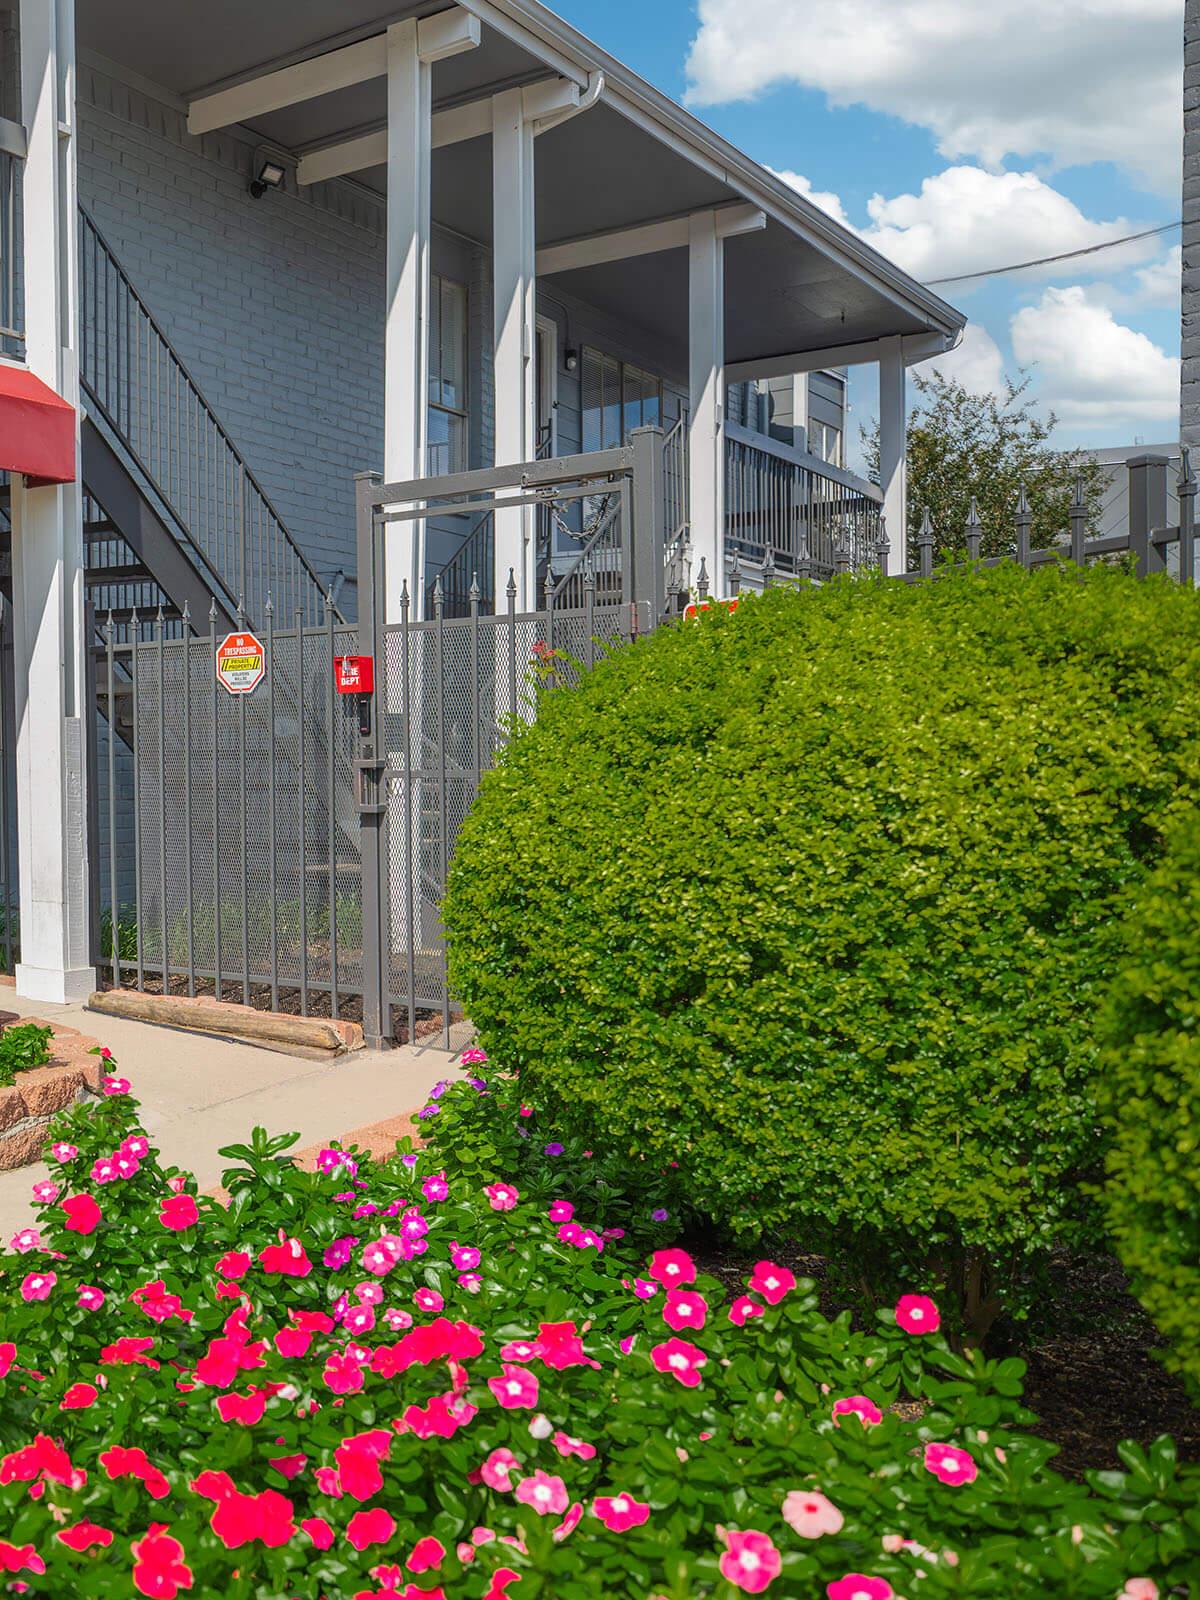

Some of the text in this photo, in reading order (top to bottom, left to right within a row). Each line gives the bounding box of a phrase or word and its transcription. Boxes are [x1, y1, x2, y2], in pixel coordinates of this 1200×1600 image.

[236, 638, 245, 646] NO
[224, 646, 257, 656] TRESPASSING
[341, 677, 360, 685] DEPT
